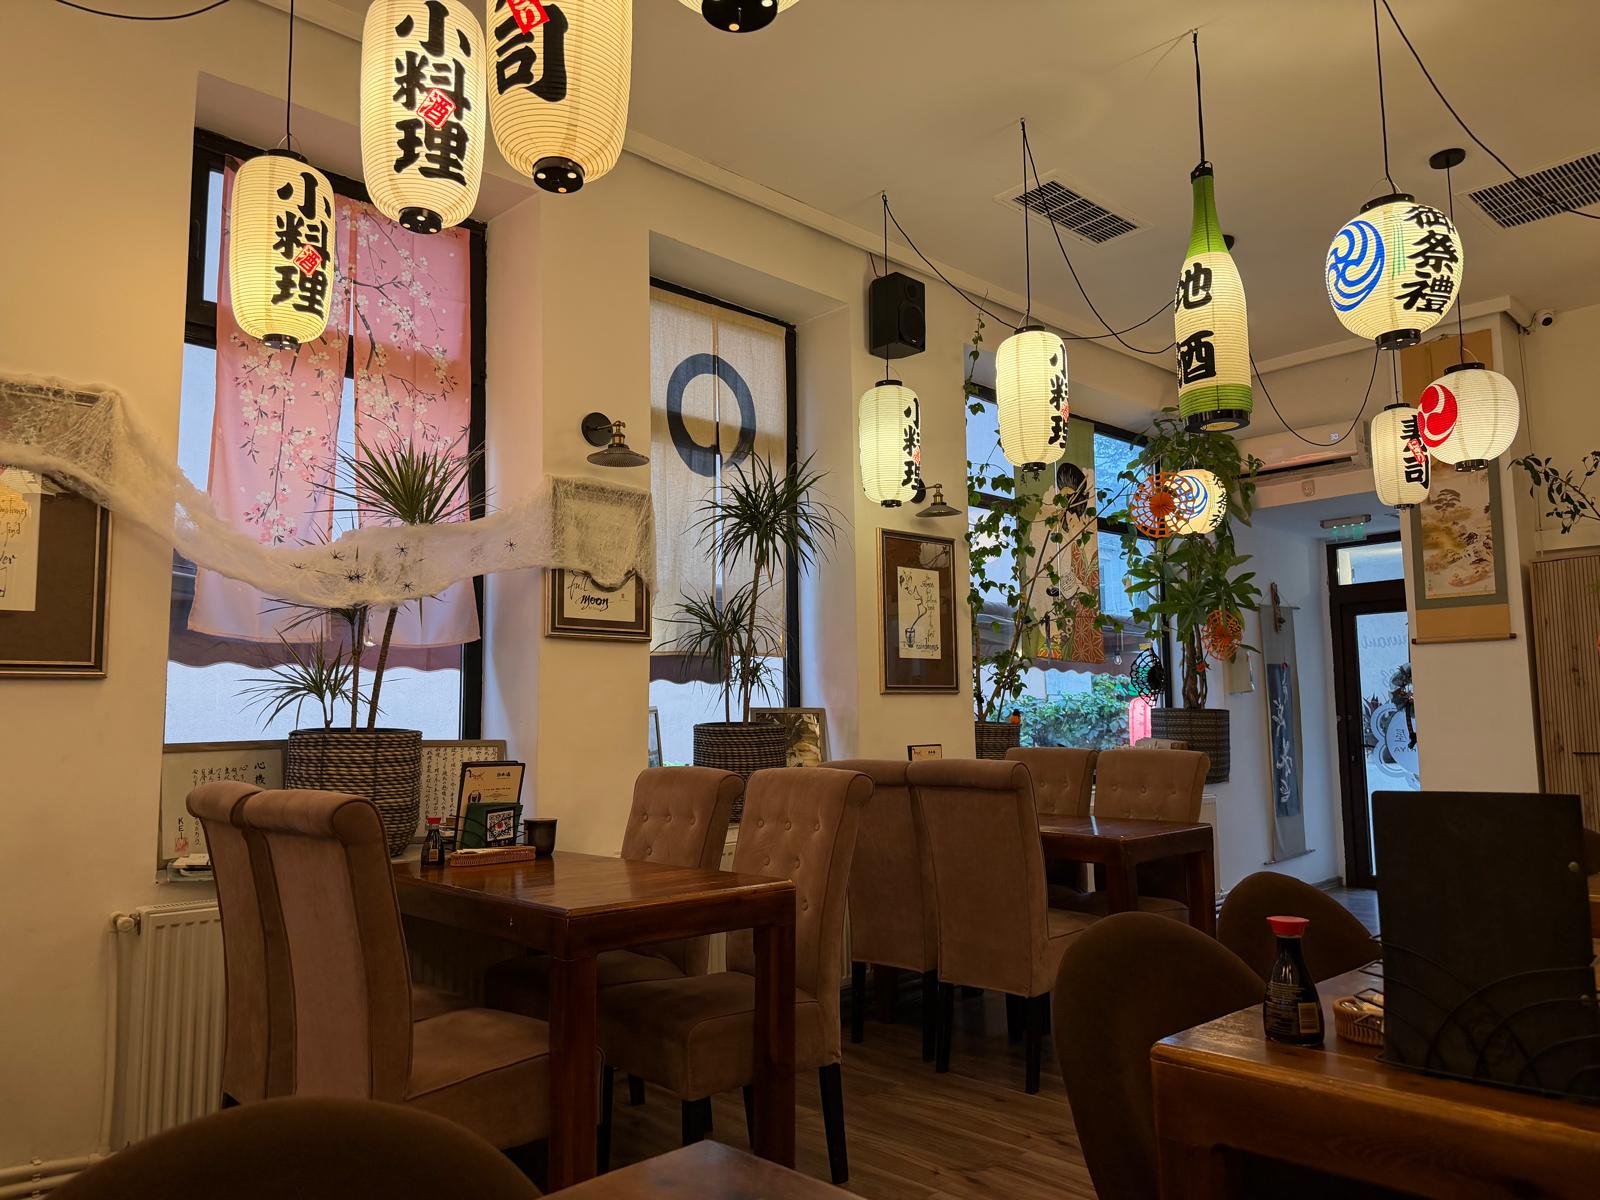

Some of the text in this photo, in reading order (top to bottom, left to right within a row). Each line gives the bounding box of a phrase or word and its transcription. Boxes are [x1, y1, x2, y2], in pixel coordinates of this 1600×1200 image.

[393, 1, 472, 187] 小料理
[493, 0, 569, 103] 司
[271, 171, 331, 320] 小料理
